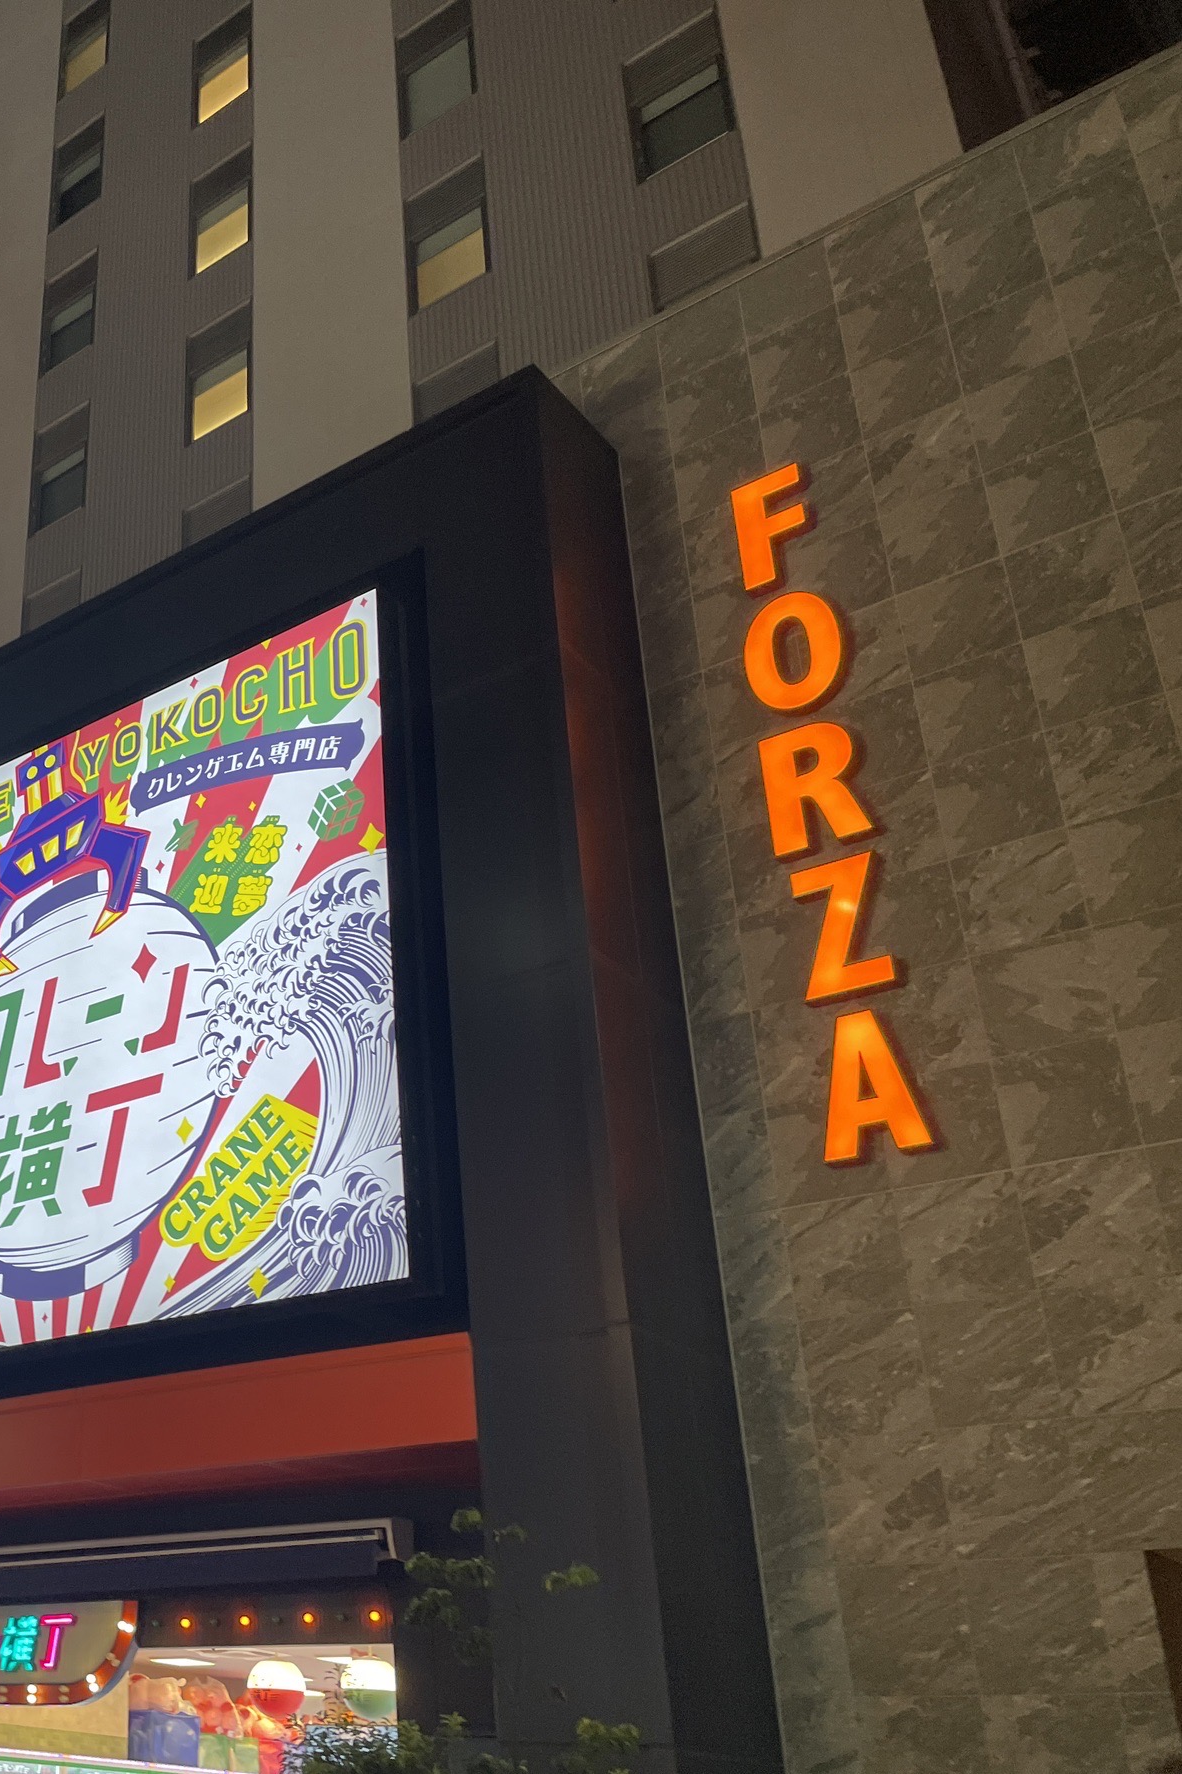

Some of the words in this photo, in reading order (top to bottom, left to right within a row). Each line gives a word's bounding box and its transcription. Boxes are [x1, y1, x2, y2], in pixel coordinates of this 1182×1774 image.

[77, 618, 367, 789] YOKOCHO
[729, 460, 935, 1165] FORZA
[164, 1098, 286, 1241] CRANE
[203, 1130, 311, 1254] GAME
